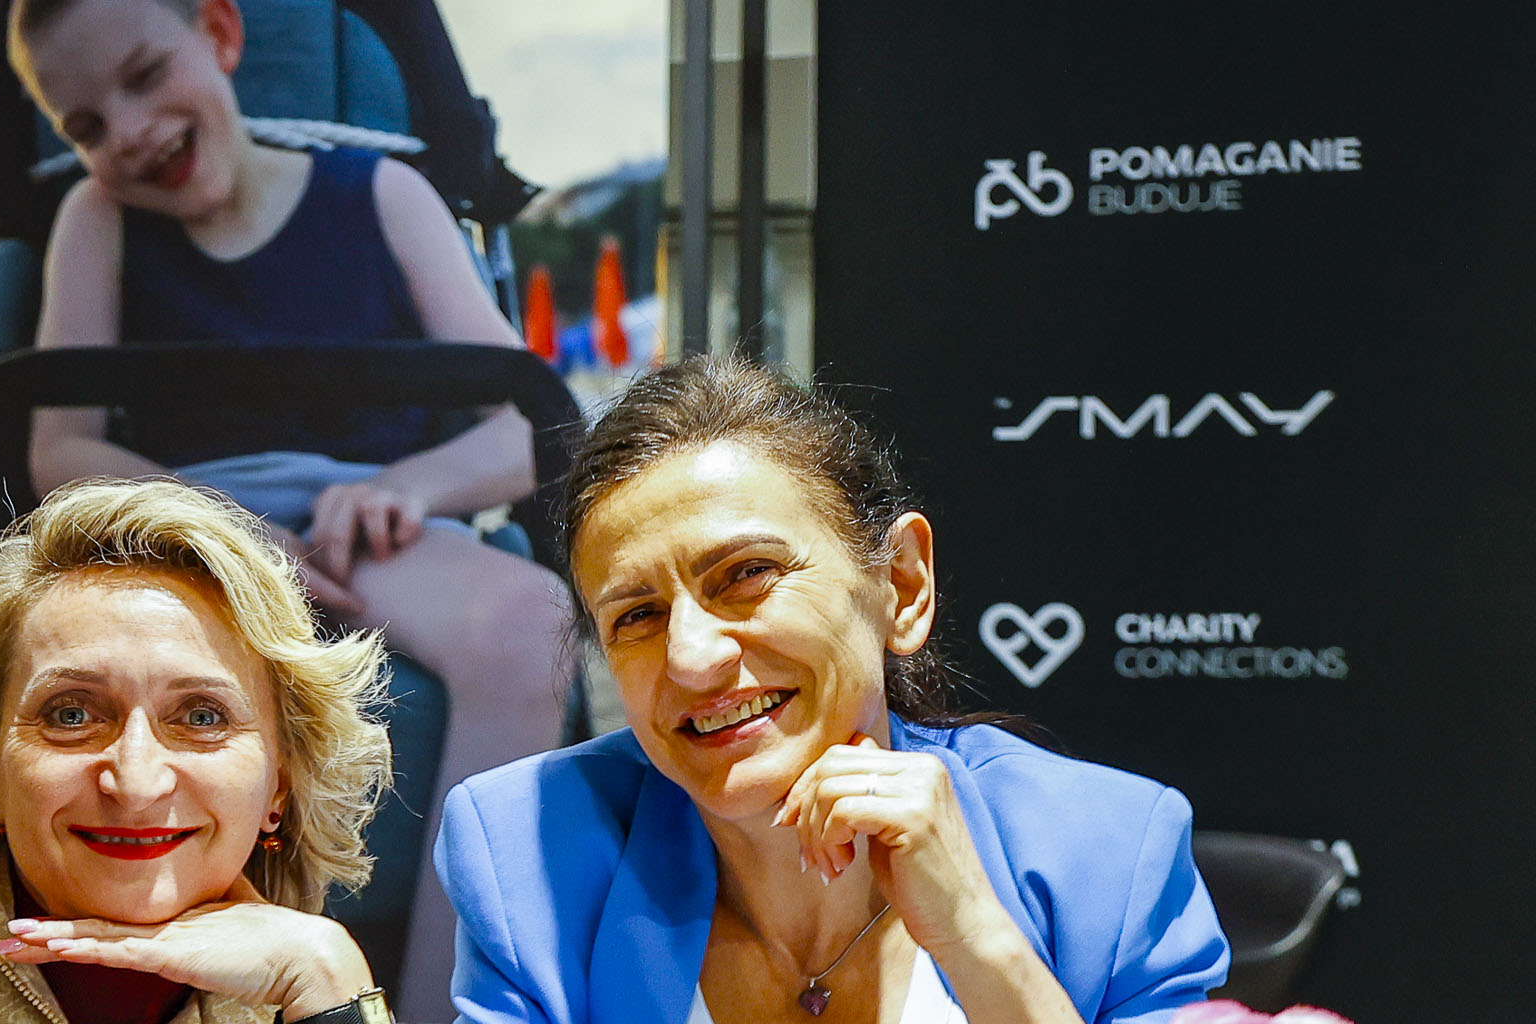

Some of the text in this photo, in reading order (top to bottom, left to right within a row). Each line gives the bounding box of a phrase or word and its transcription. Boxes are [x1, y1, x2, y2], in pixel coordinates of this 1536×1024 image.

[1089, 137, 1362, 182] POMAGANIE
[1088, 180, 1243, 216] BUDUJE
[1115, 612, 1261, 643] CHARITY
[1114, 646, 1349, 679] CONNECTIONS
